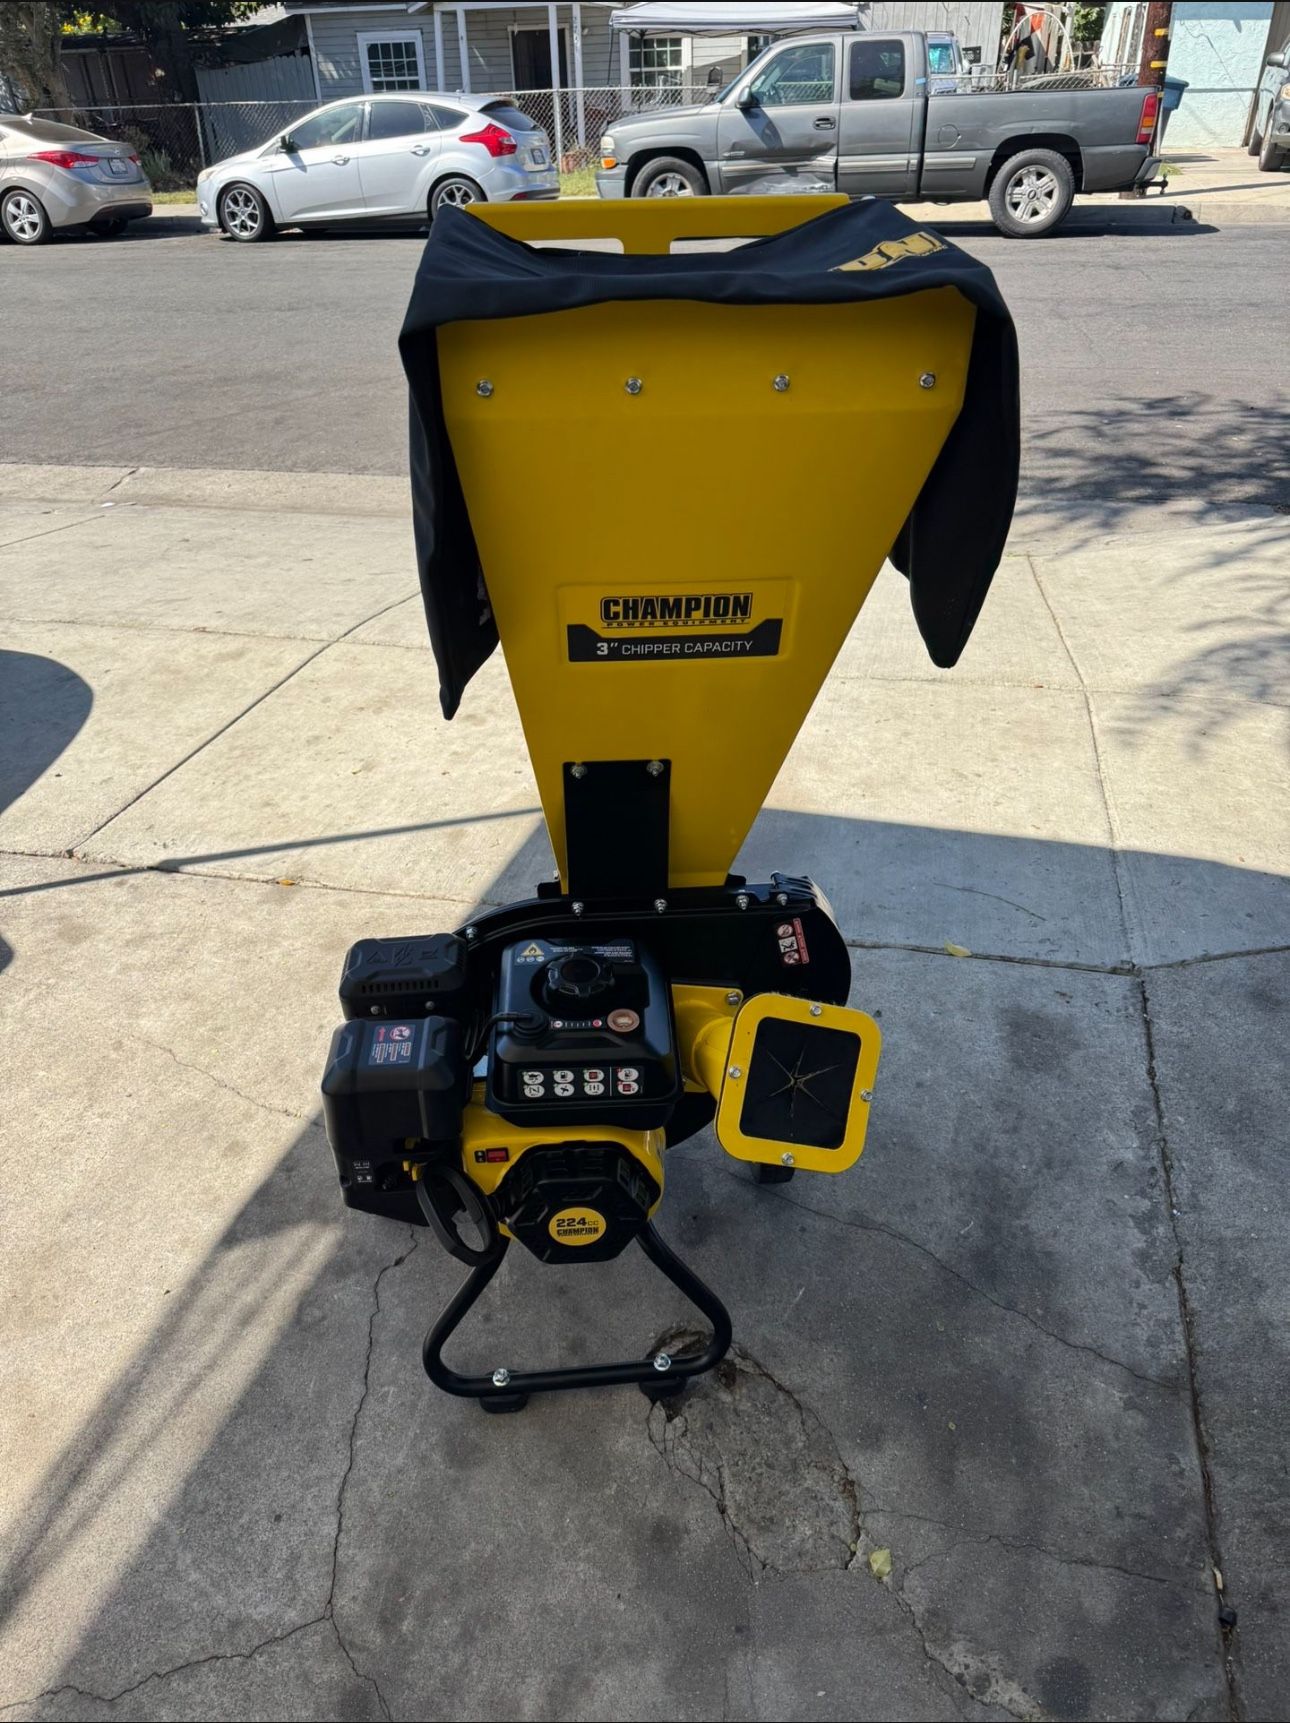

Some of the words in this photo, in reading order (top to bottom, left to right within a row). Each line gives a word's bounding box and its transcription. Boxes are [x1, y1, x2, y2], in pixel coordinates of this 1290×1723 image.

[602, 595, 750, 621] CHAMPION
[596, 642, 618, 655] 3"
[622, 643, 681, 655] CHIPPER
[684, 640, 753, 653] CAPACITY
[557, 1227, 599, 1236] CHAMPION
